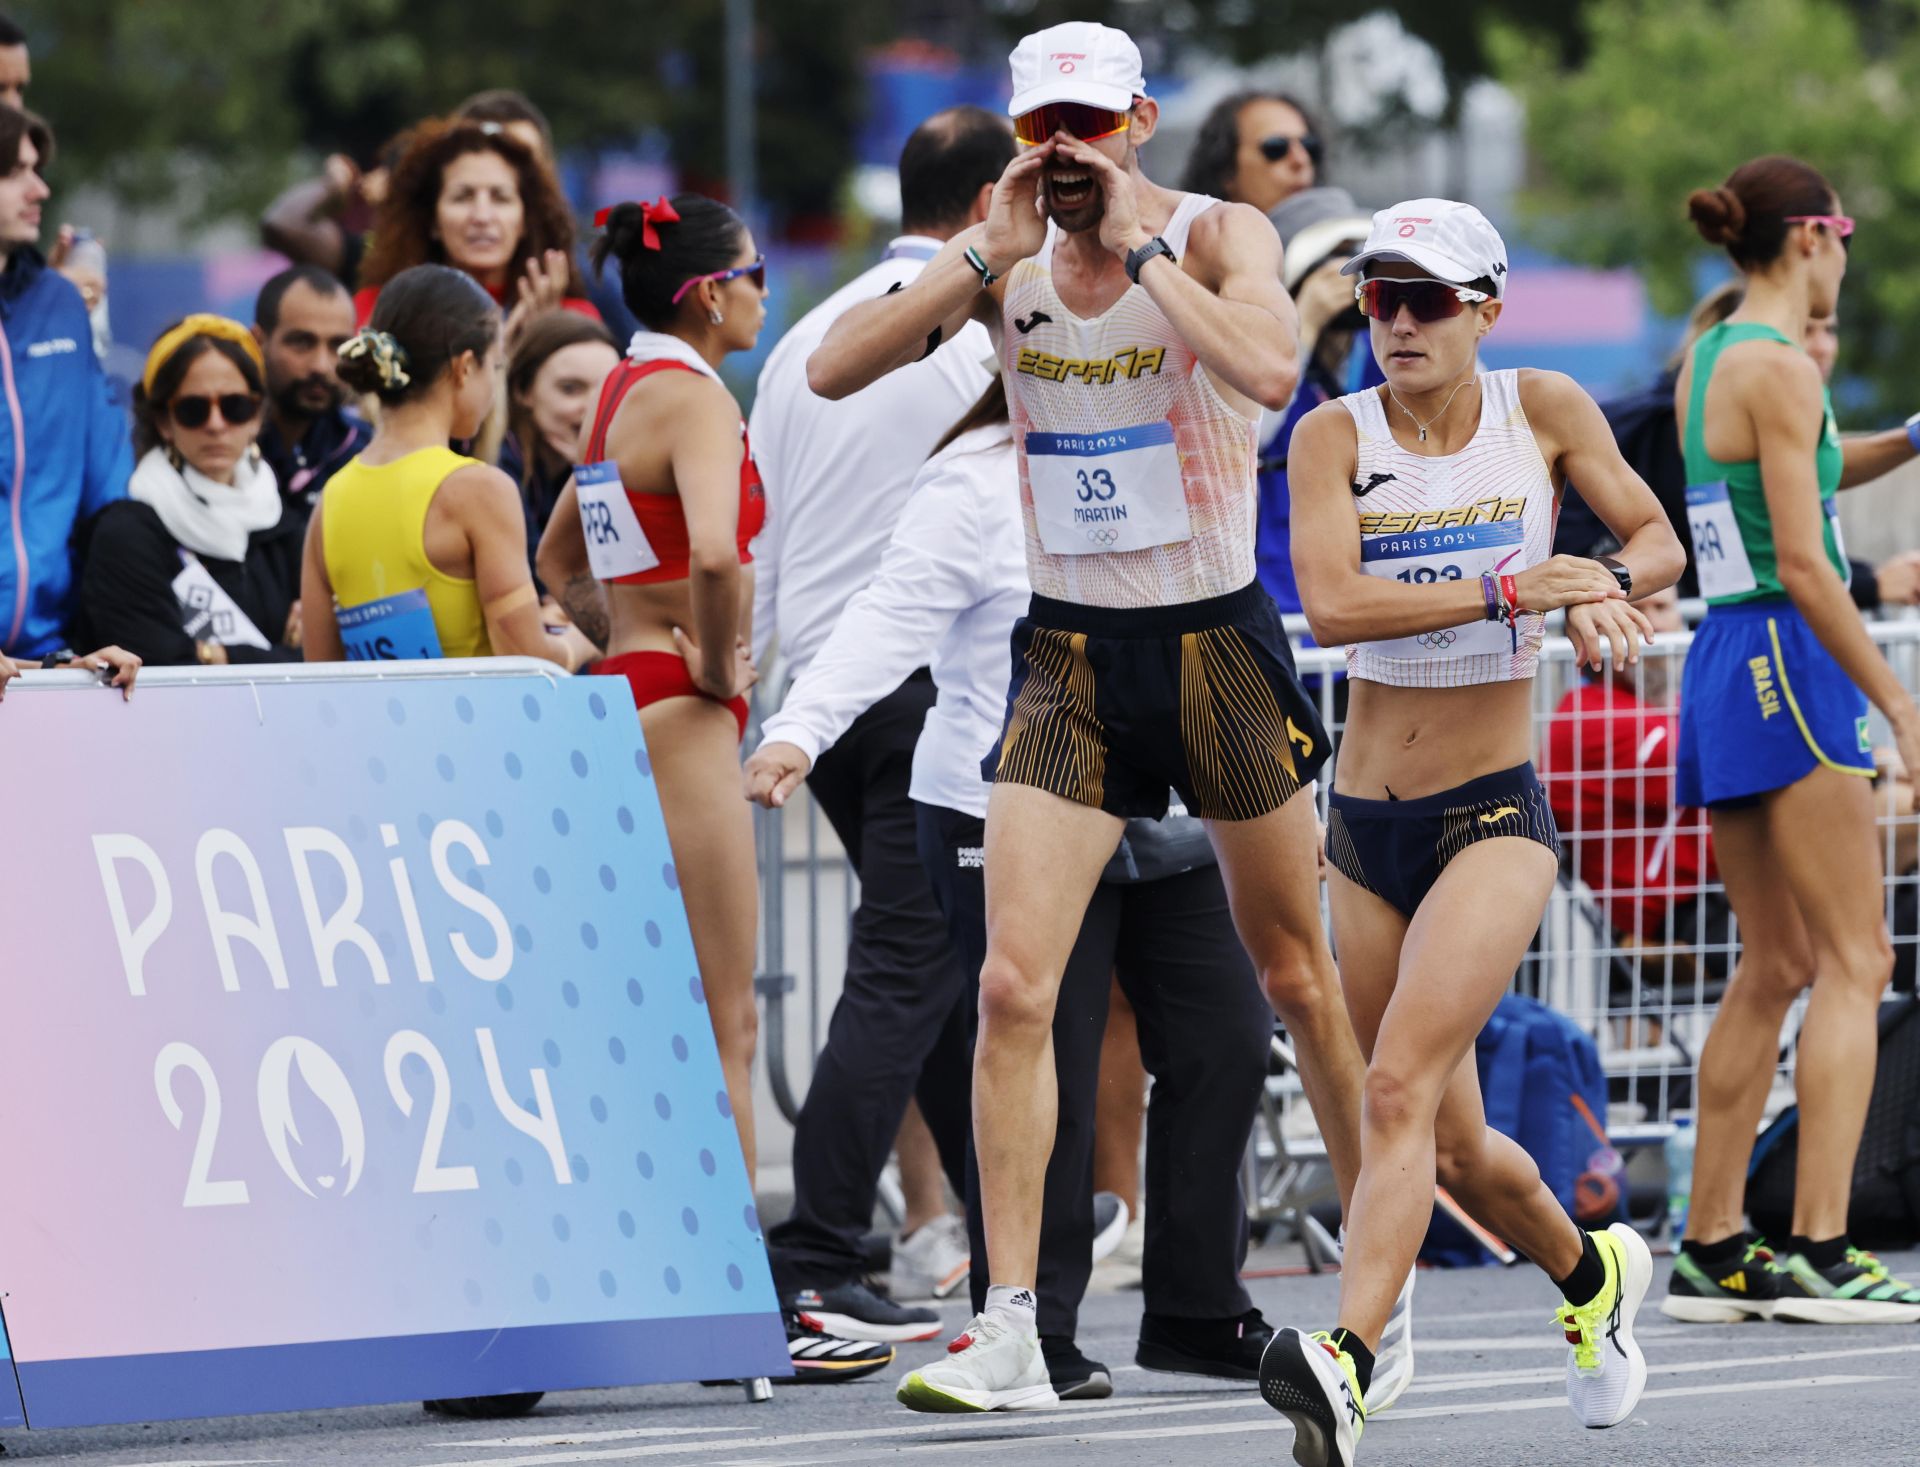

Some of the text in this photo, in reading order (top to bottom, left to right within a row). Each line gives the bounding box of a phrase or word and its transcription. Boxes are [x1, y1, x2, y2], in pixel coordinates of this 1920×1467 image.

[1017, 346, 1166, 384] ESPAÑA
[1088, 435, 1127, 450] 2024
[1076, 469, 1116, 502] 33
[1074, 505, 1127, 523] MARTIN
[1360, 497, 1527, 534] ESPAÑA
[1433, 532, 1476, 548] 2024
[1747, 655, 1781, 721] BRASIL
[154, 1027, 573, 1207] 2024
